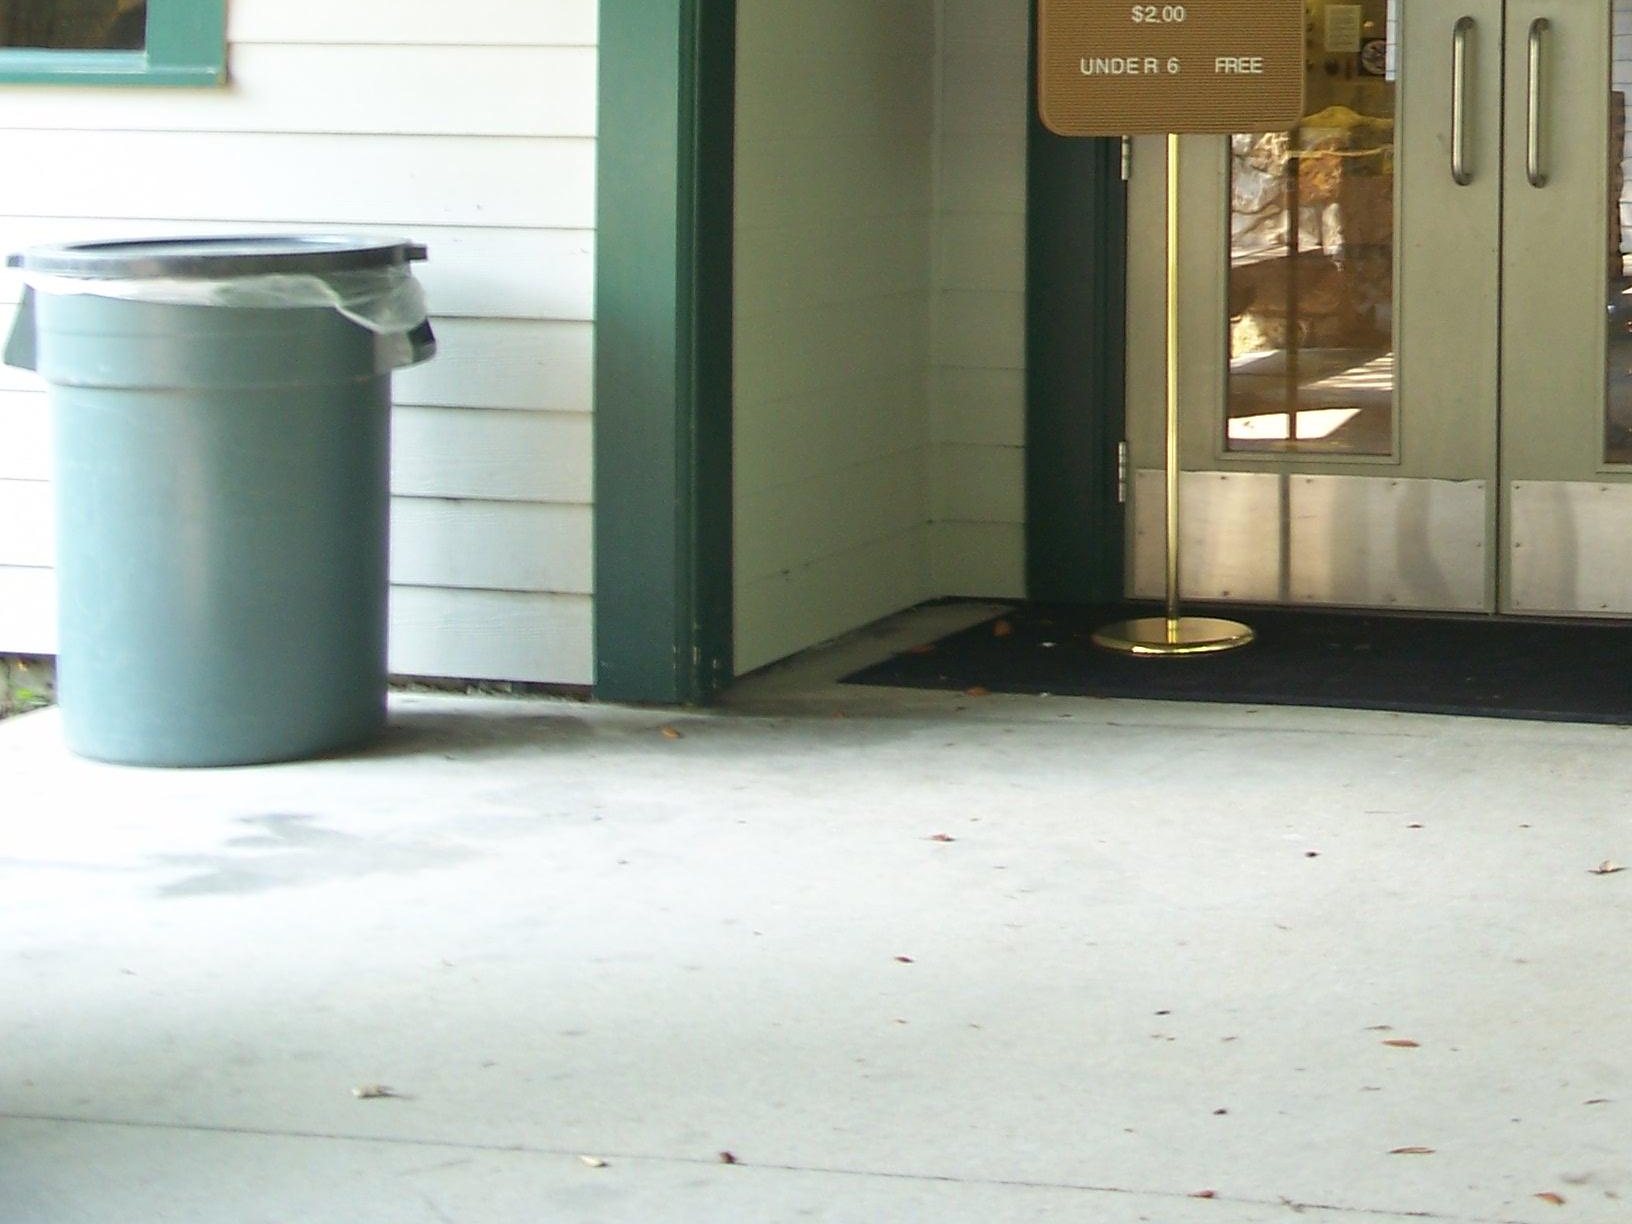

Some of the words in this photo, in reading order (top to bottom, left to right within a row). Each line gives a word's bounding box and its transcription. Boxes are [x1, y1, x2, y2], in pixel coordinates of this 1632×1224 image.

[1131, 5, 1186, 24] $2.00
[1080, 58, 1159, 75] UNDER
[1167, 57, 1181, 75] 6
[1215, 57, 1264, 75] FREE
